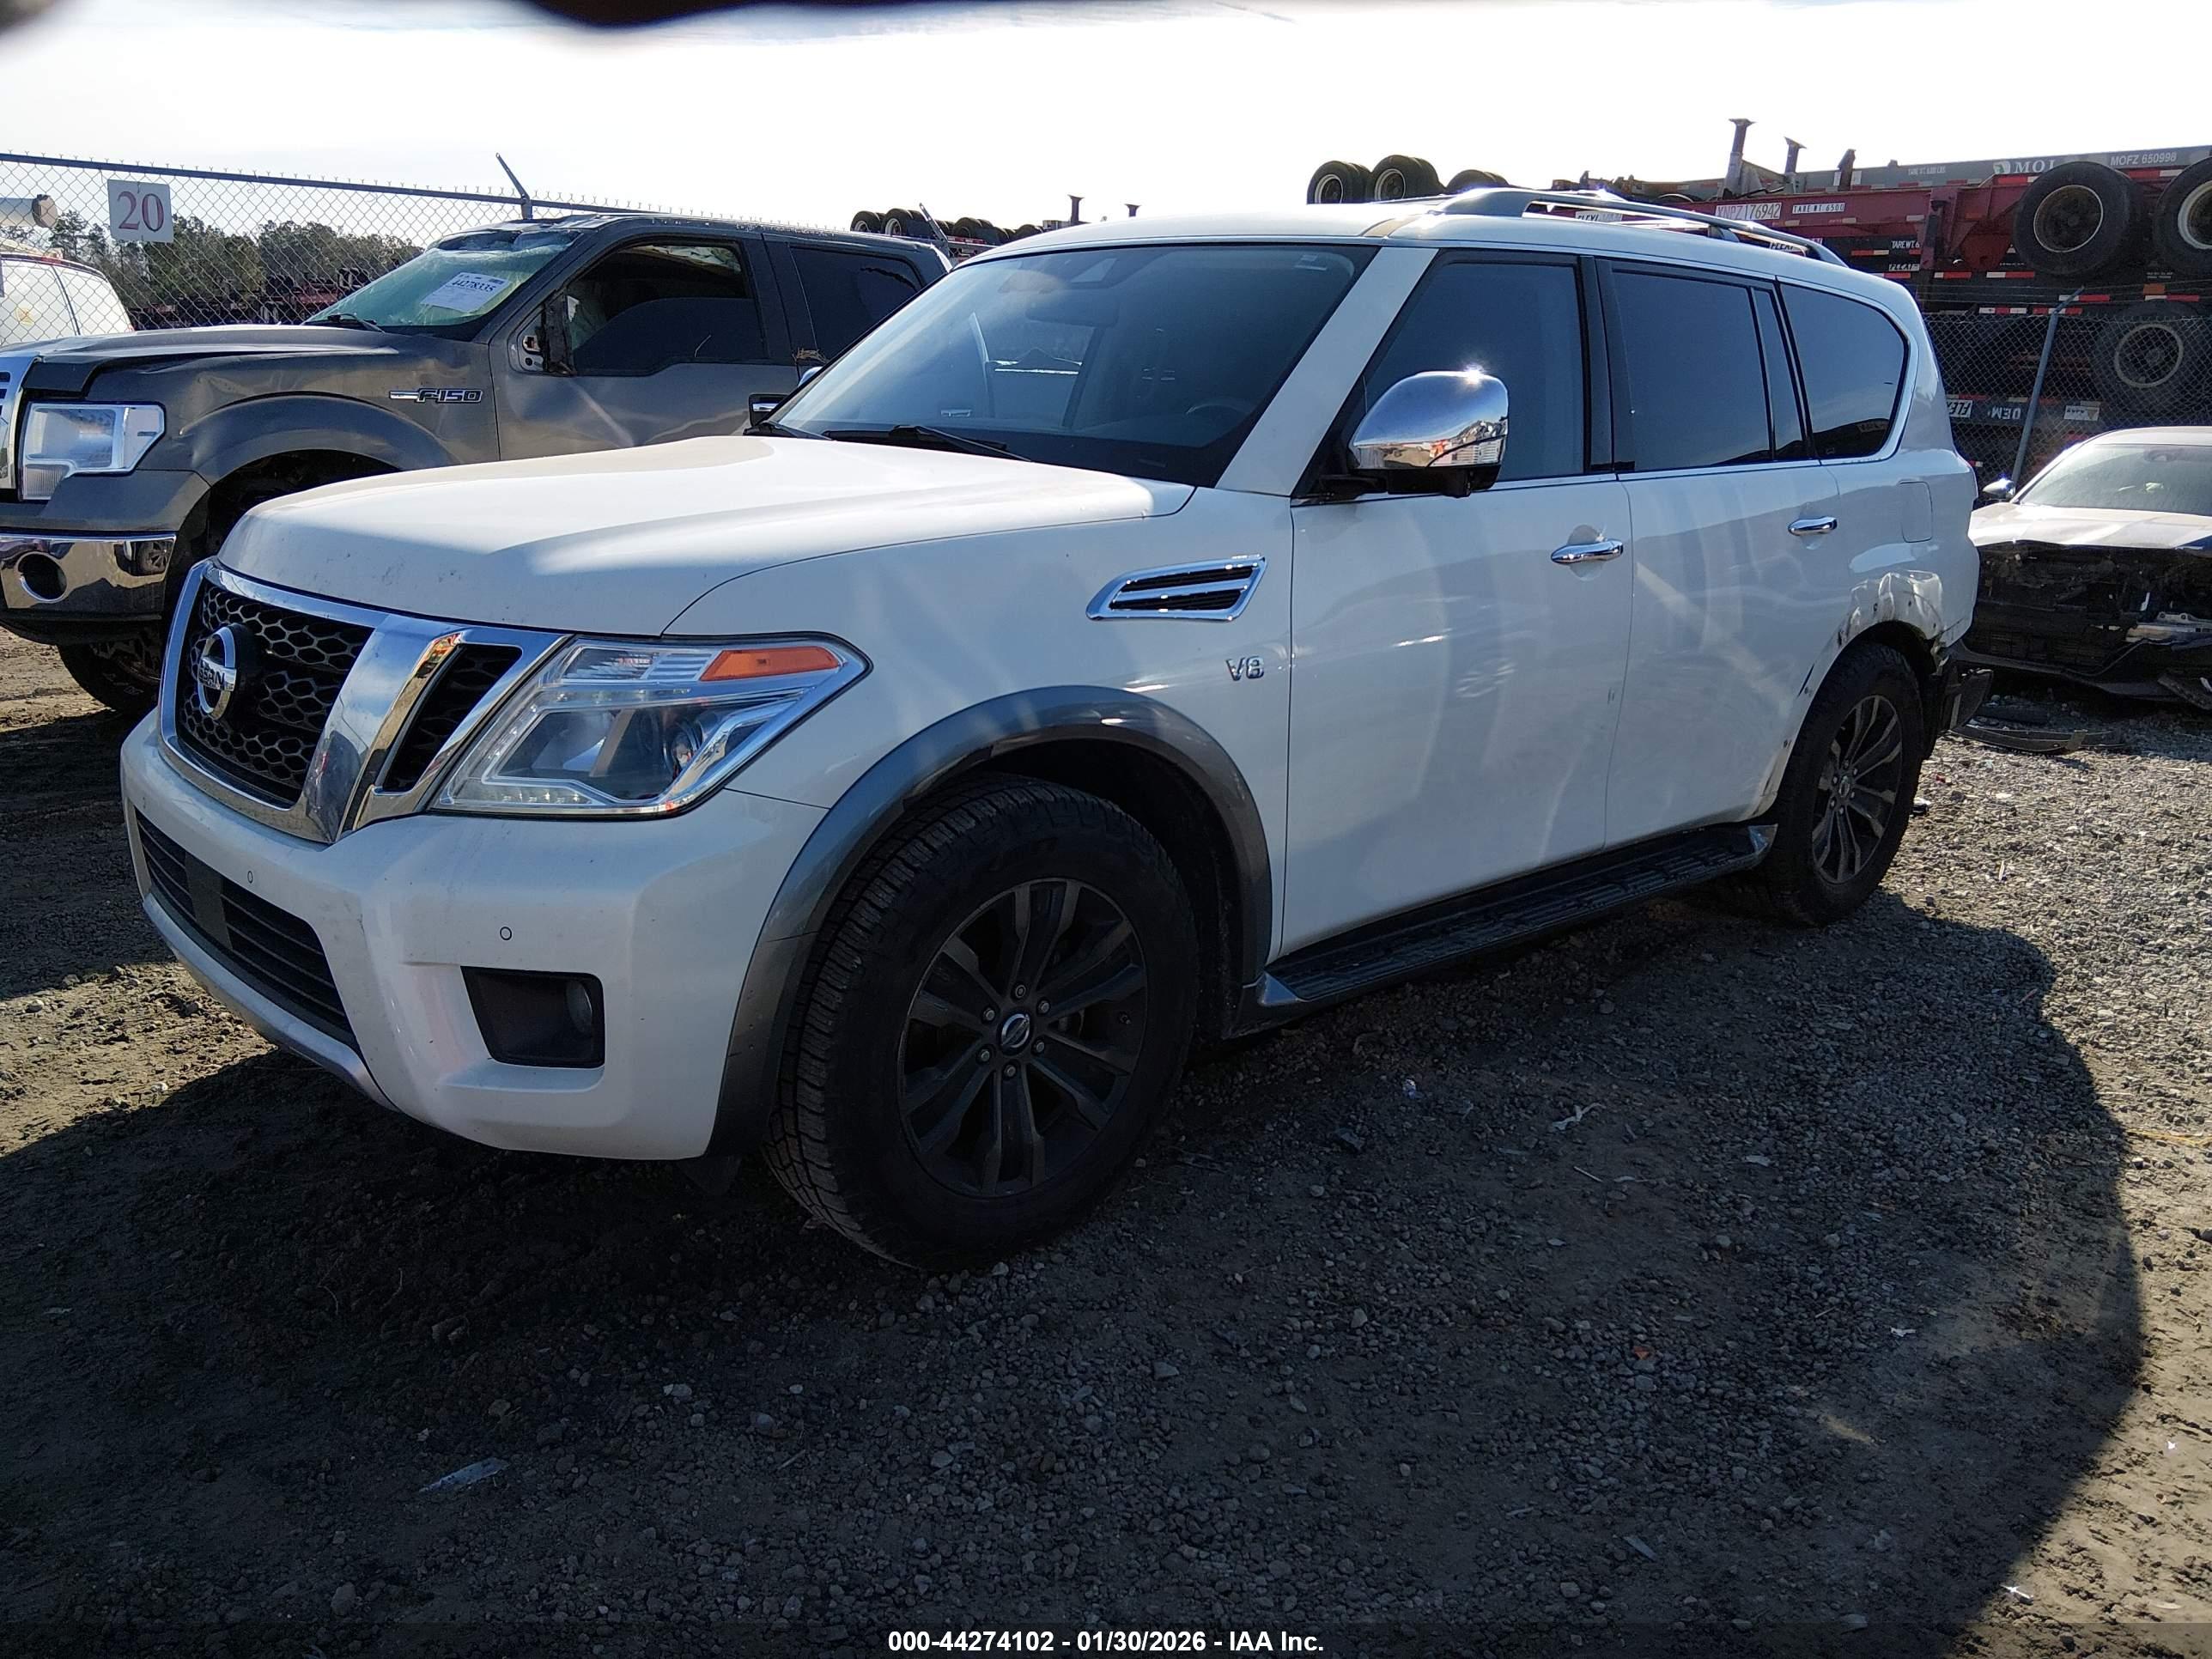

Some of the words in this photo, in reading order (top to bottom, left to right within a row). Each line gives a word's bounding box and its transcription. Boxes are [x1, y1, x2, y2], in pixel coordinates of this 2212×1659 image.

[2110, 155, 2139, 166] MOFZ
[2142, 152, 2177, 163] 650998
[117, 191, 164, 233] 20
[415, 388, 483, 404] F-150
[1225, 655, 1265, 682] V8
